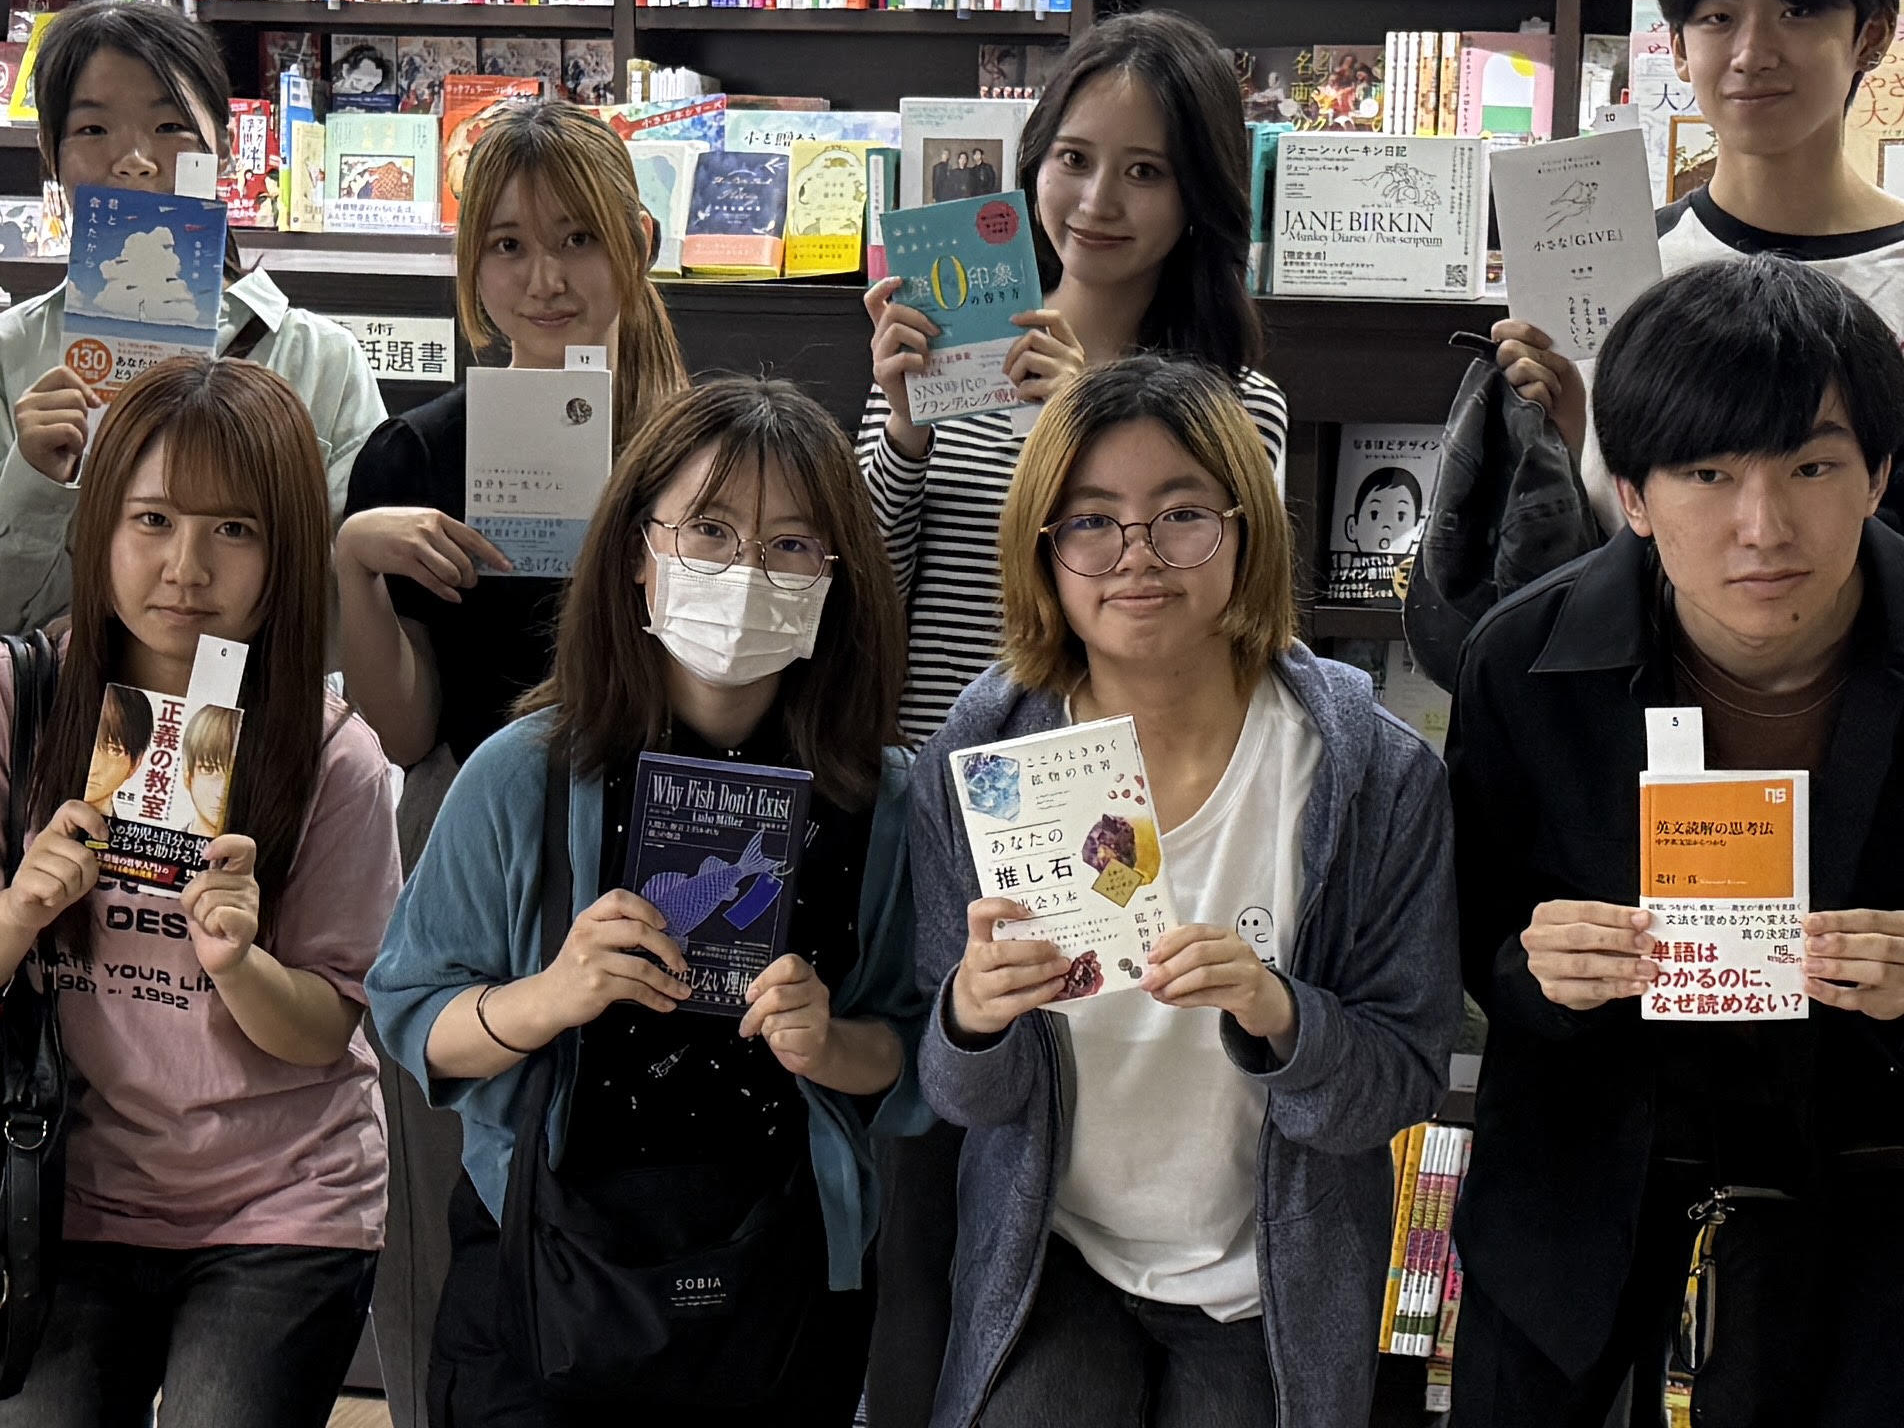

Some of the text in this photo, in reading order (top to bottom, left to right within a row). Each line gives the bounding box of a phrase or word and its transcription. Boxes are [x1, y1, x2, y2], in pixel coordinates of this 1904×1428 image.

[1281, 210, 1435, 236] JANE BIRKIN
[71, 348, 107, 370] 130
[139, 699, 185, 821] 正義の教室
[1025, 739, 1117, 769] こころときめく
[653, 775, 791, 820] Why Fish Don't Exist
[1656, 820, 1775, 837] 英文読解の思考法
[991, 828, 1063, 855] あなたの
[995, 855, 1073, 891] 推し石
[105, 905, 190, 940] DES
[1741, 928, 1802, 940] 真の決定版
[1650, 940, 1719, 964] 単語は
[104, 963, 170, 986] YOUR
[1651, 967, 1772, 989] わかるのに、
[132, 986, 189, 1010] 1992
[1651, 992, 1803, 1015] なぜ読めない?
[676, 1277, 721, 1291] SOBIA
